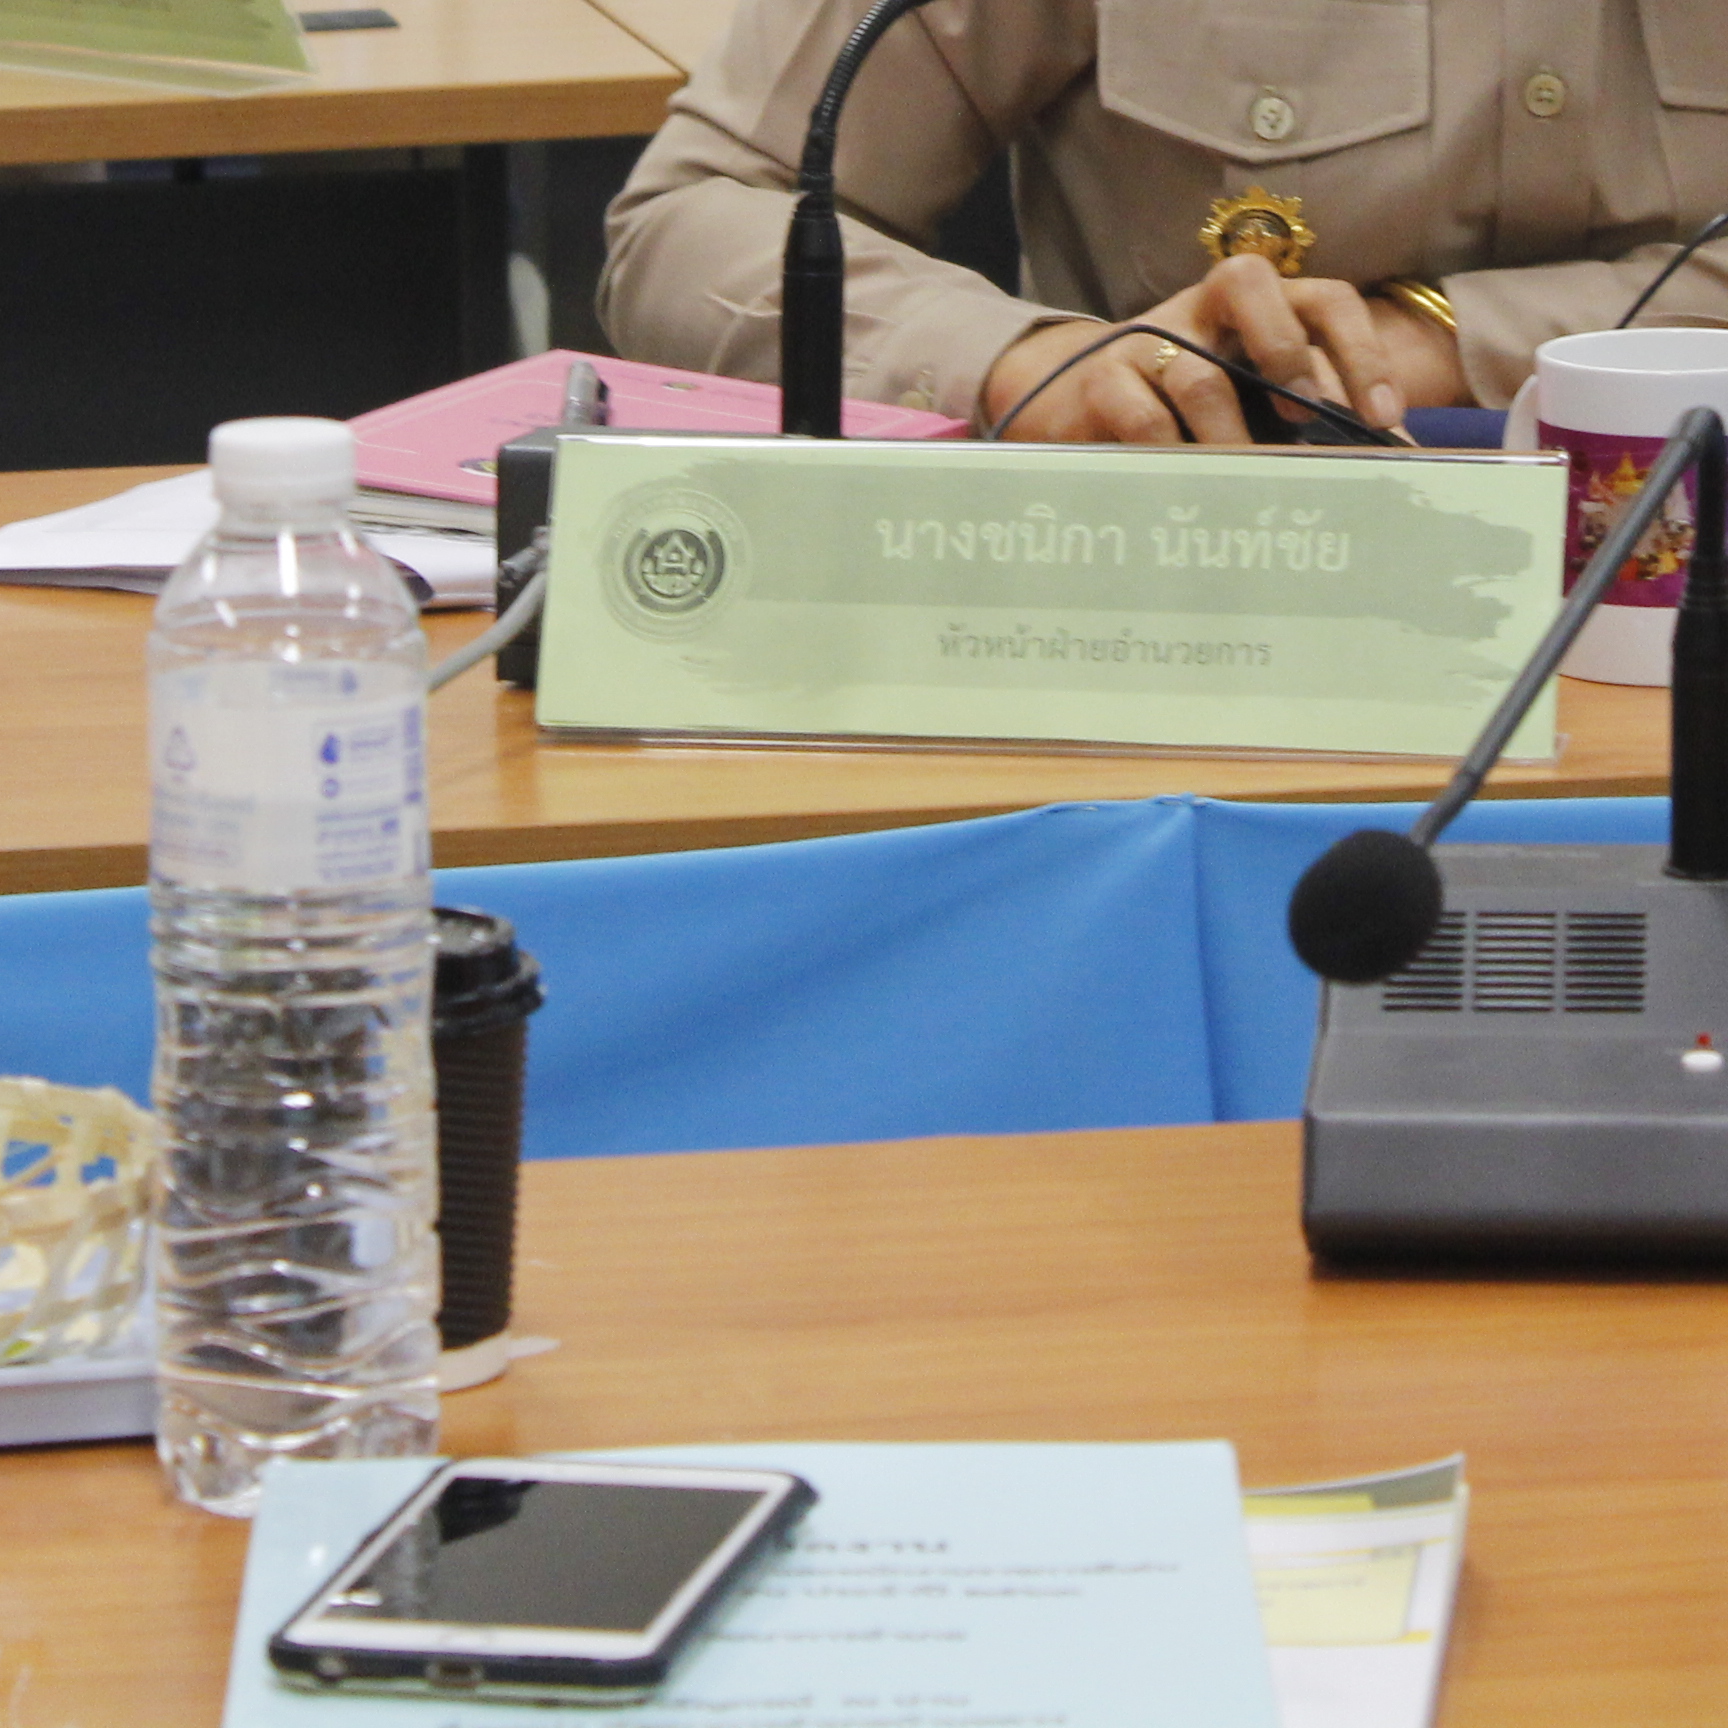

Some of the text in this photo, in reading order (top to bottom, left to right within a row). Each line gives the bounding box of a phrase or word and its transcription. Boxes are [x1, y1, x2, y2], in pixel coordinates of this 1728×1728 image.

[873, 502, 1351, 572] นางชนิกา นันท์ชัย
[935, 621, 1273, 668] หัวหน้าฝ่ายอำนวยการ
